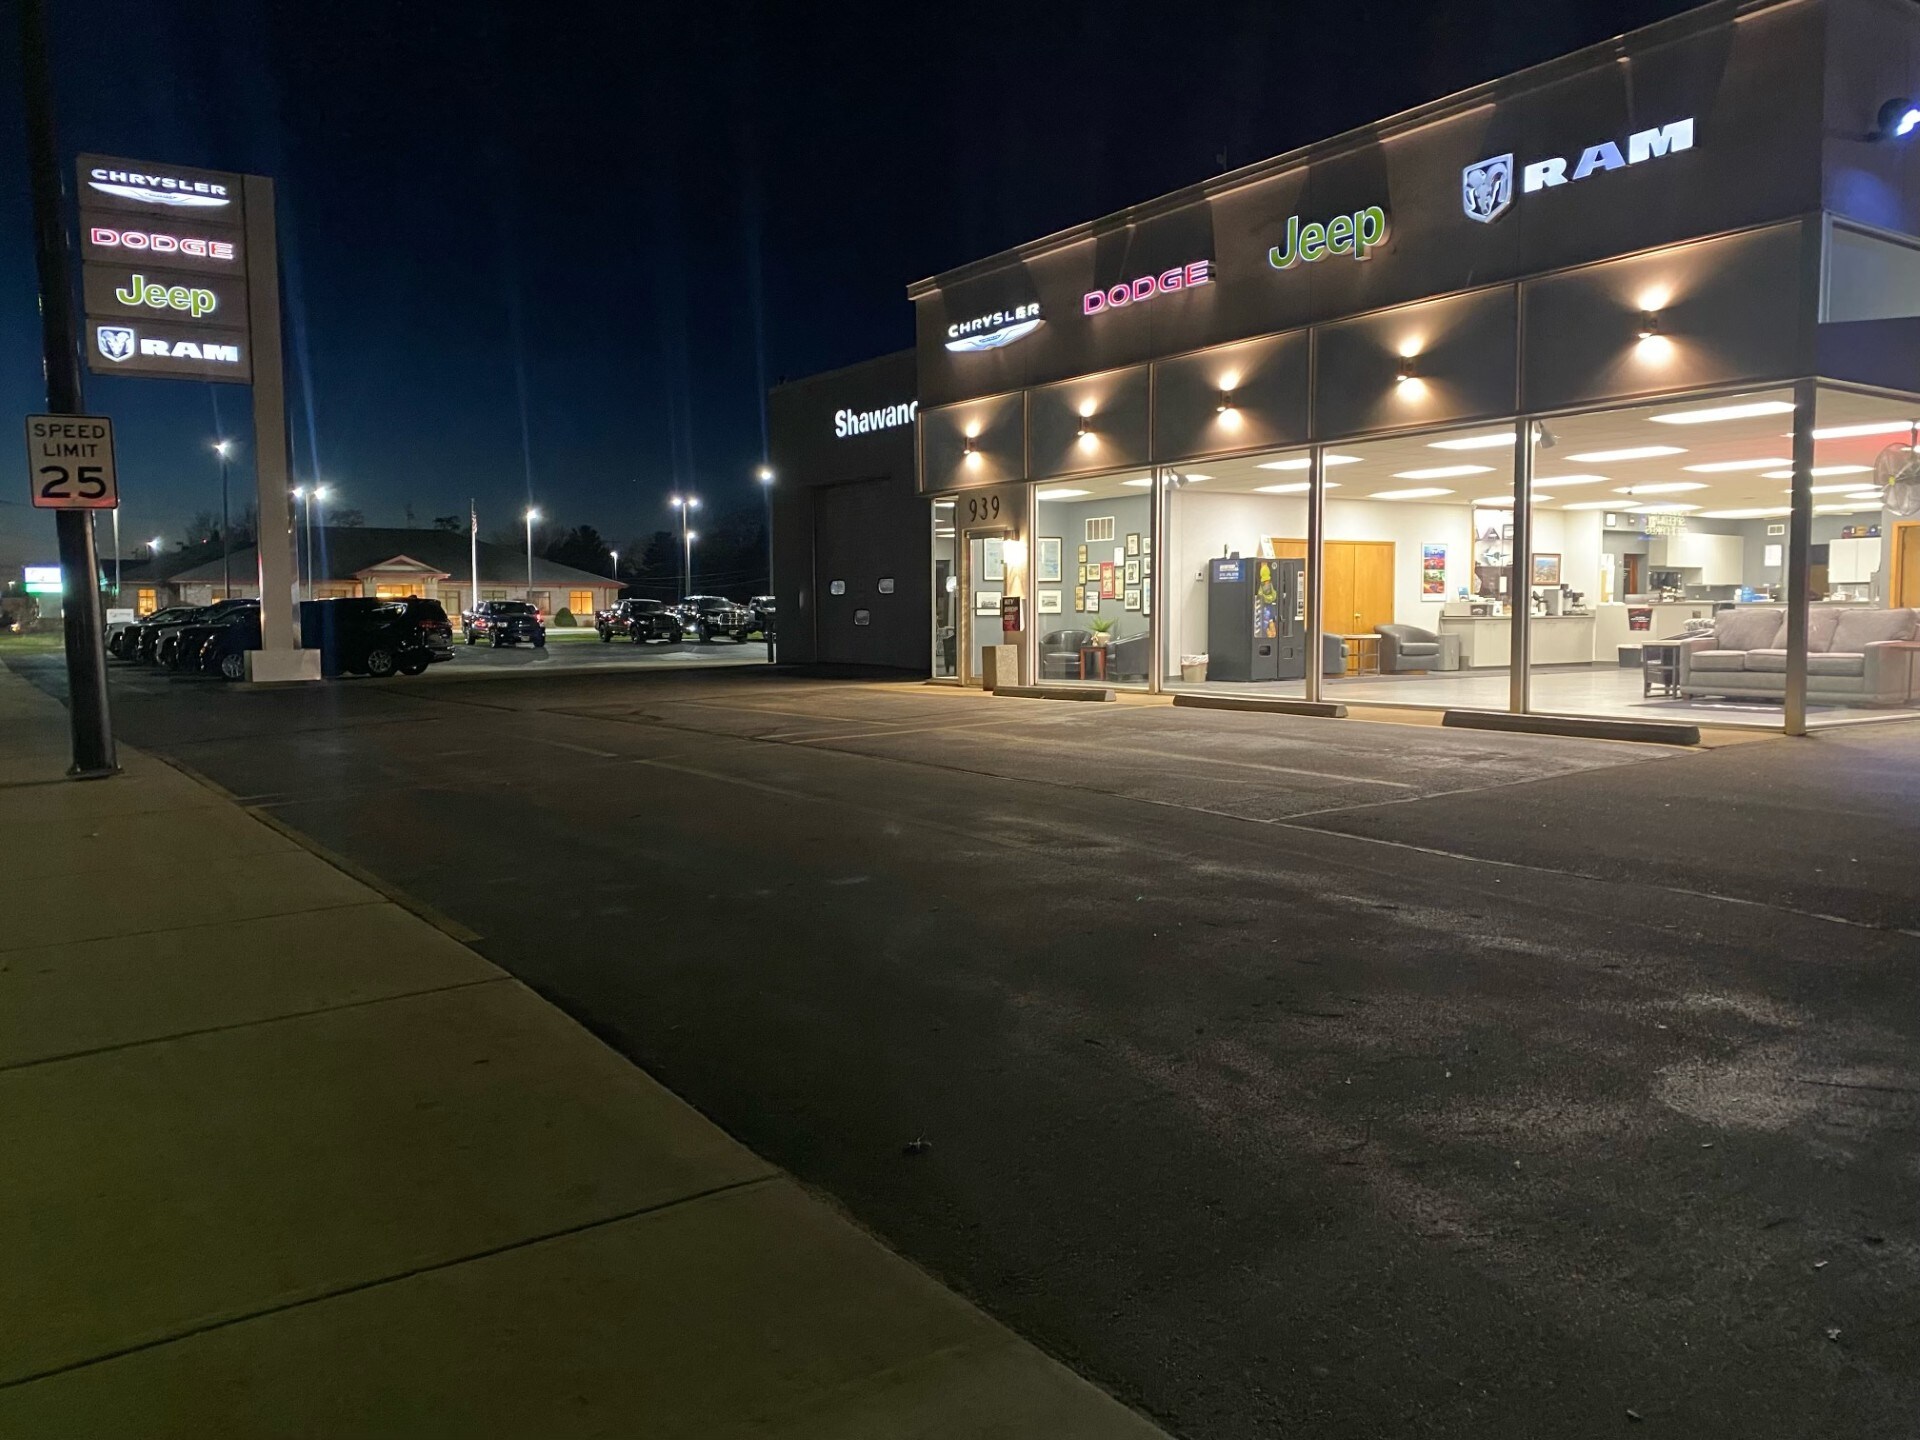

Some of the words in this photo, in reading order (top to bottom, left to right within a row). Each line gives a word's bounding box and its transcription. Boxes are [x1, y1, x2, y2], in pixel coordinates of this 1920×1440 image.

[1524, 117, 1694, 193] RAM
[91, 168, 227, 195] CHRYSLER
[90, 227, 234, 260] DODGE
[1269, 206, 1386, 270] Jeep
[115, 274, 217, 318] Jeep
[1083, 260, 1210, 316] DODGE
[948, 303, 1040, 338] CHRYSLER
[140, 338, 239, 363] RAM
[33, 423, 106, 439] SPEED
[43, 443, 98, 458] LIMIT
[40, 465, 107, 499] 25
[969, 495, 1000, 522] 939
